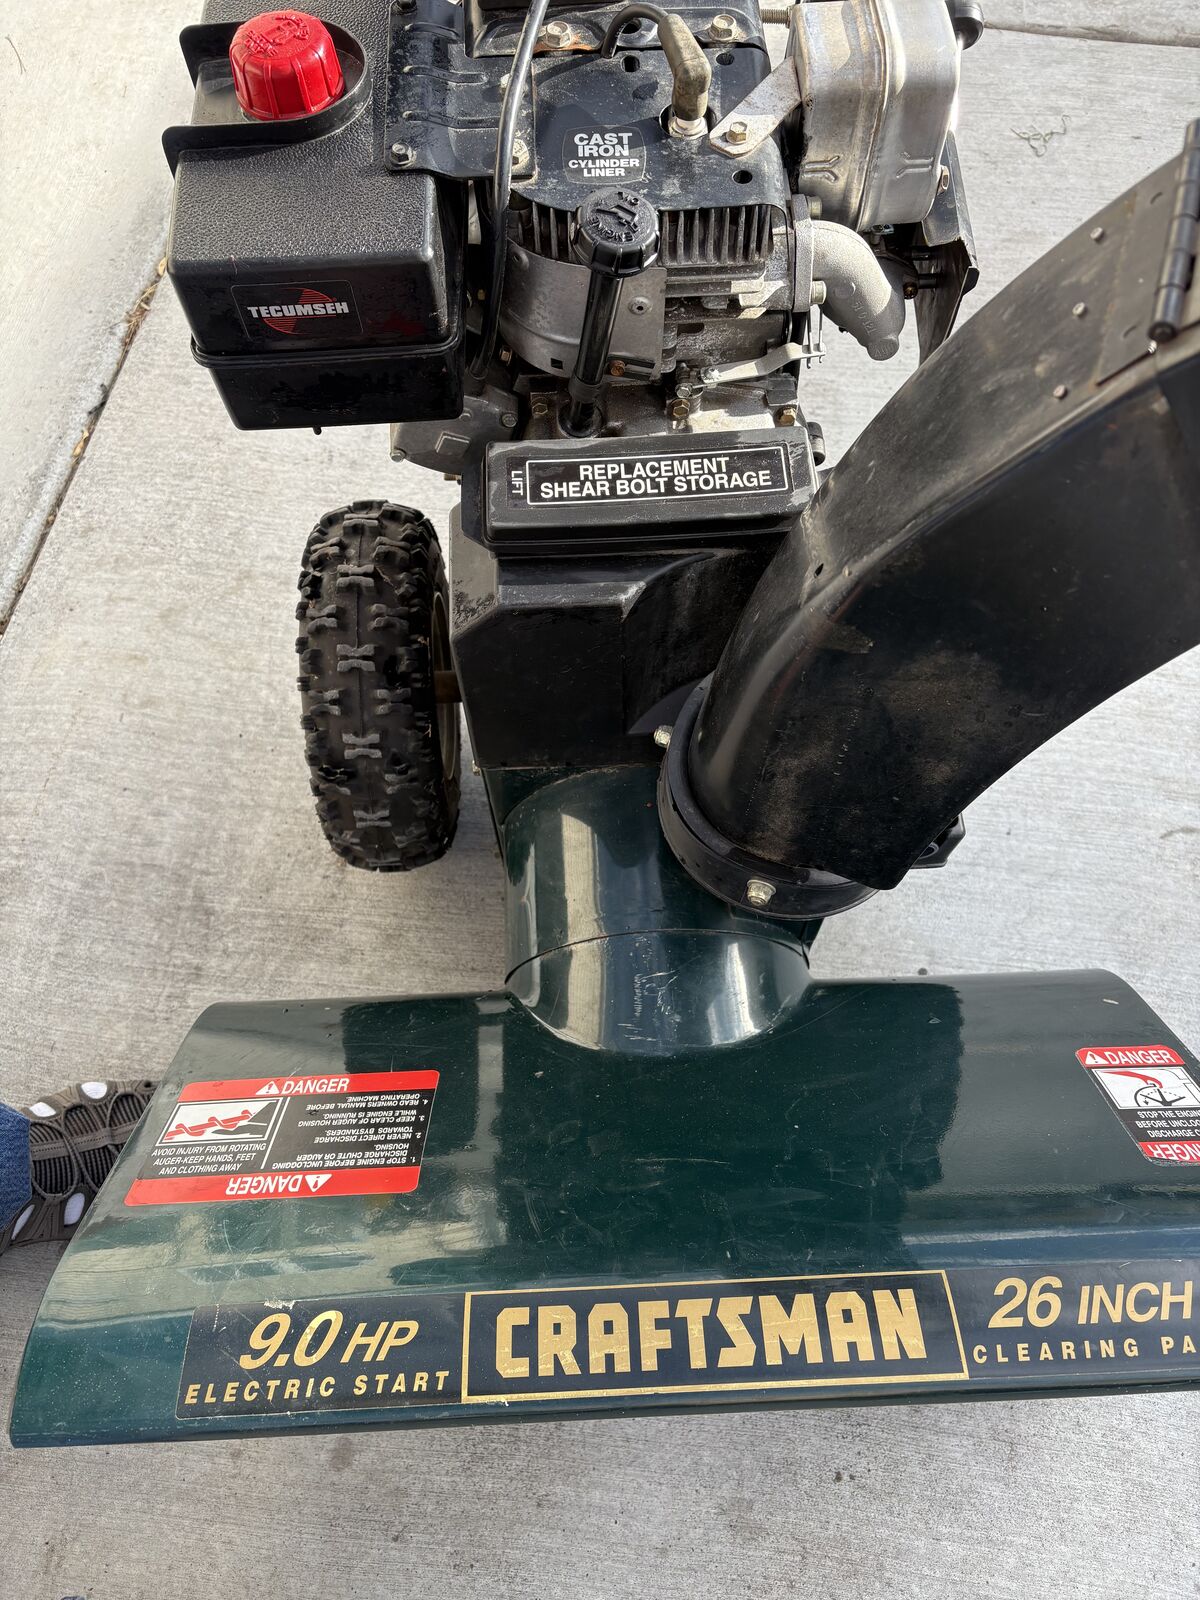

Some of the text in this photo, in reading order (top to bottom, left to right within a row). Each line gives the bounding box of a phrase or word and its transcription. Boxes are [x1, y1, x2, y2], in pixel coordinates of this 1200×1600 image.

[574, 132, 632, 146] CAST
[578, 144, 630, 157] IRON
[568, 158, 640, 168] CYLINDER
[584, 168, 626, 177] LINER
[247, 302, 350, 318] TECUMSEH
[579, 457, 730, 480] REPLACEMENT
[511, 470, 524, 495] LIFT
[540, 470, 772, 498] SHEAR BOLT STORAGE
[1104, 1050, 1176, 1065] DANGER
[282, 1078, 350, 1094] DANGER
[229, 1143, 266, 1152] ROTATING
[153, 1156, 204, 1165] AUGER-KEEP
[159, 1167, 176, 1175] AND
[177, 1165, 217, 1173] CLOTHING
[226, 1174, 303, 1195] DANGER
[988, 1276, 1193, 1329] 26 INCH
[239, 1310, 420, 1370] 9.0 HP
[496, 1288, 928, 1379] CRAFTSMAN
[973, 1338, 1139, 1364] CLEARING
[184, 1370, 450, 1404] ELECTRIC START
